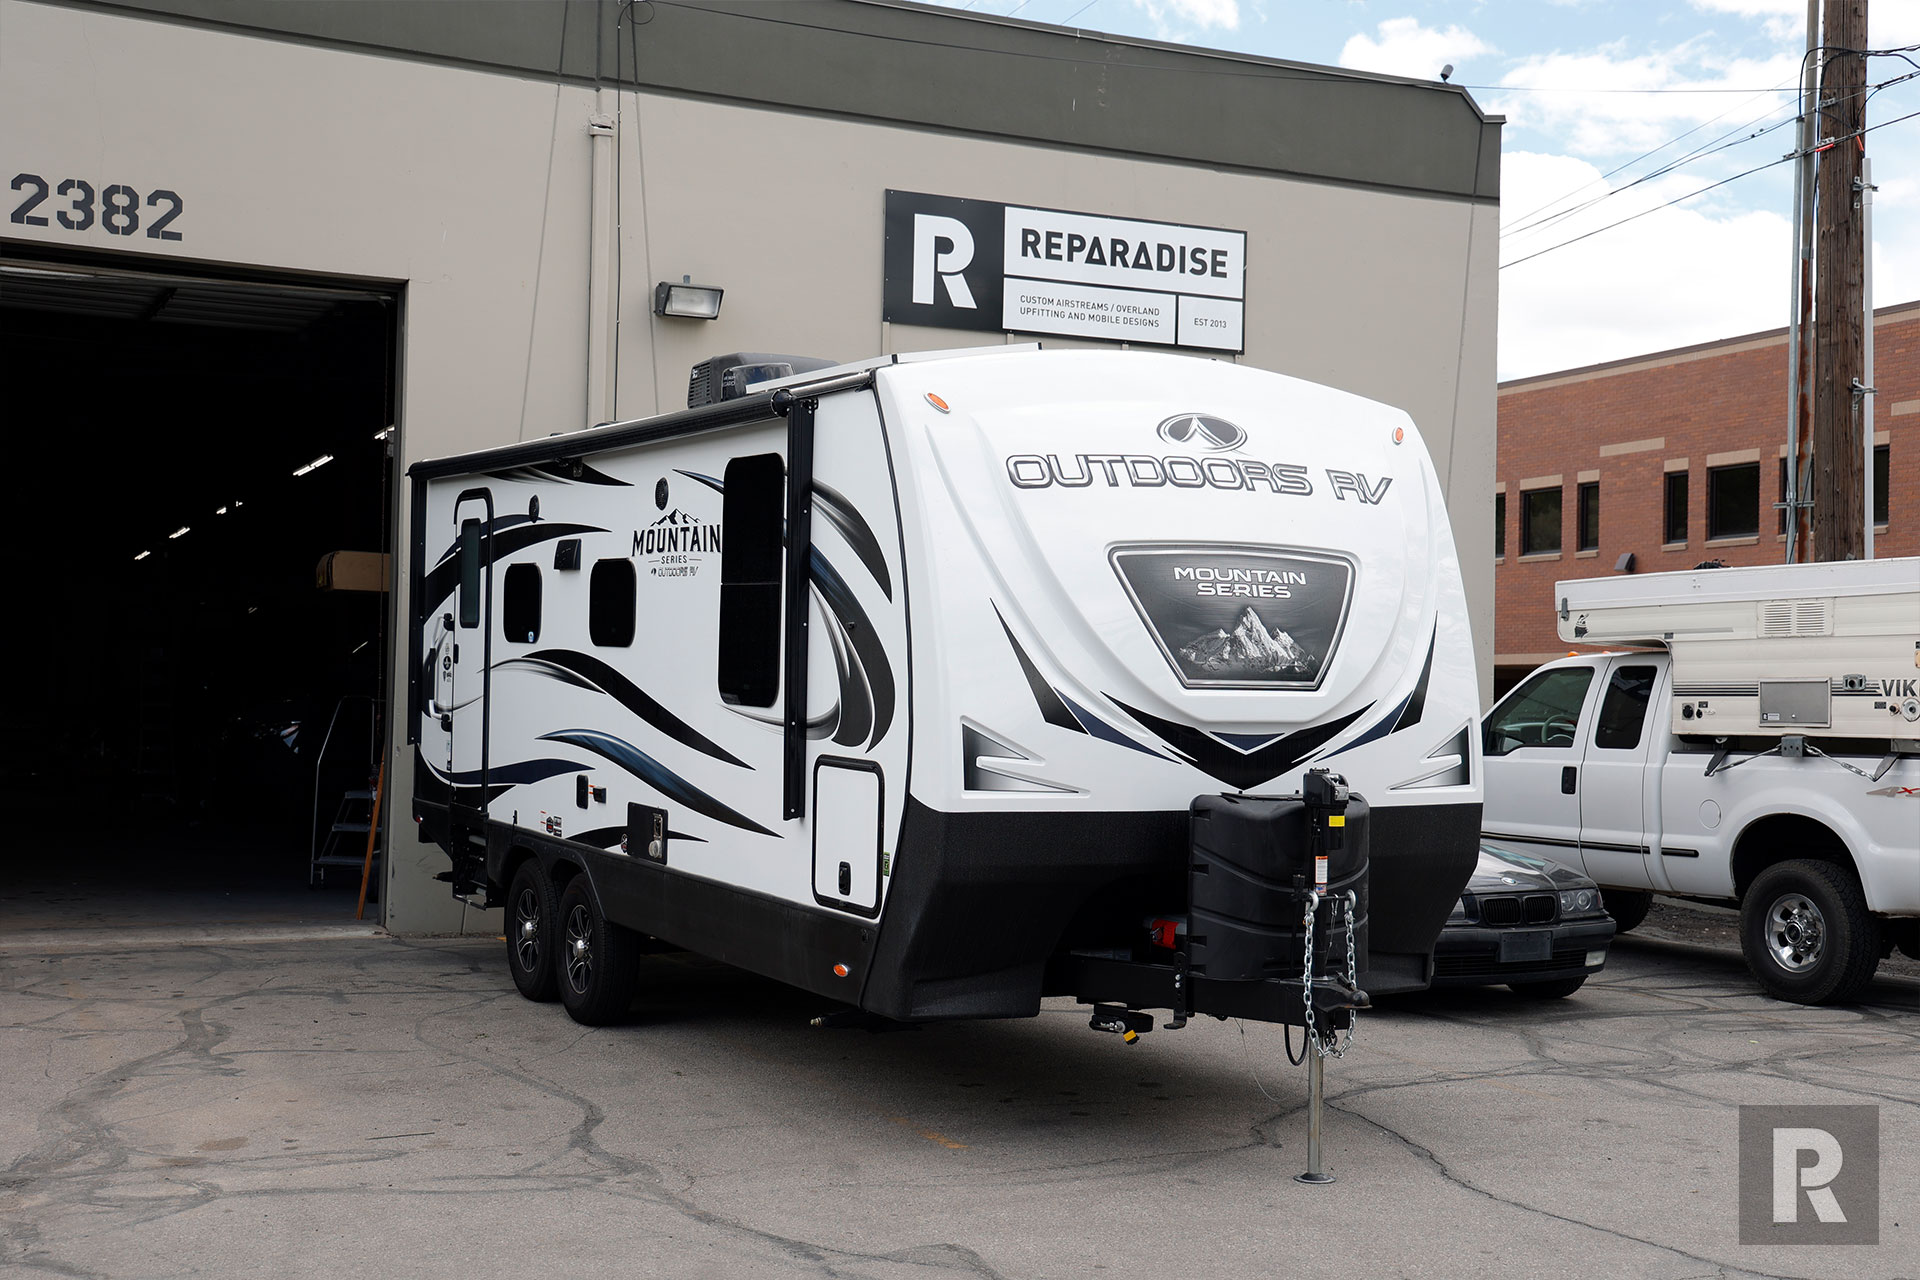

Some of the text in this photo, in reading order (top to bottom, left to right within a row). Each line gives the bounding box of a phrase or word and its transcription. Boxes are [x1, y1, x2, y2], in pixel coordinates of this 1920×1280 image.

[10, 172, 183, 242] 2382
[912, 213, 978, 310] R
[1021, 228, 1228, 279] REPARADISE
[1020, 294, 1055, 306] CUSTOM
[1056, 299, 1109, 312] AIRSTREAMS
[1116, 304, 1160, 316] OVERLAND
[1019, 307, 1160, 328] UPFITTING AND MOBILE DESIGNS
[1194, 317, 1227, 329] EST 2013
[1005, 454, 1393, 505] OUTDOORS RV
[631, 524, 722, 557] MOUNTAIN
[660, 555, 688, 565] SERIES
[1173, 566, 1307, 586] MOUNTAIN
[1195, 582, 1293, 599] SERIES
[1881, 679, 1920, 697] VIK
